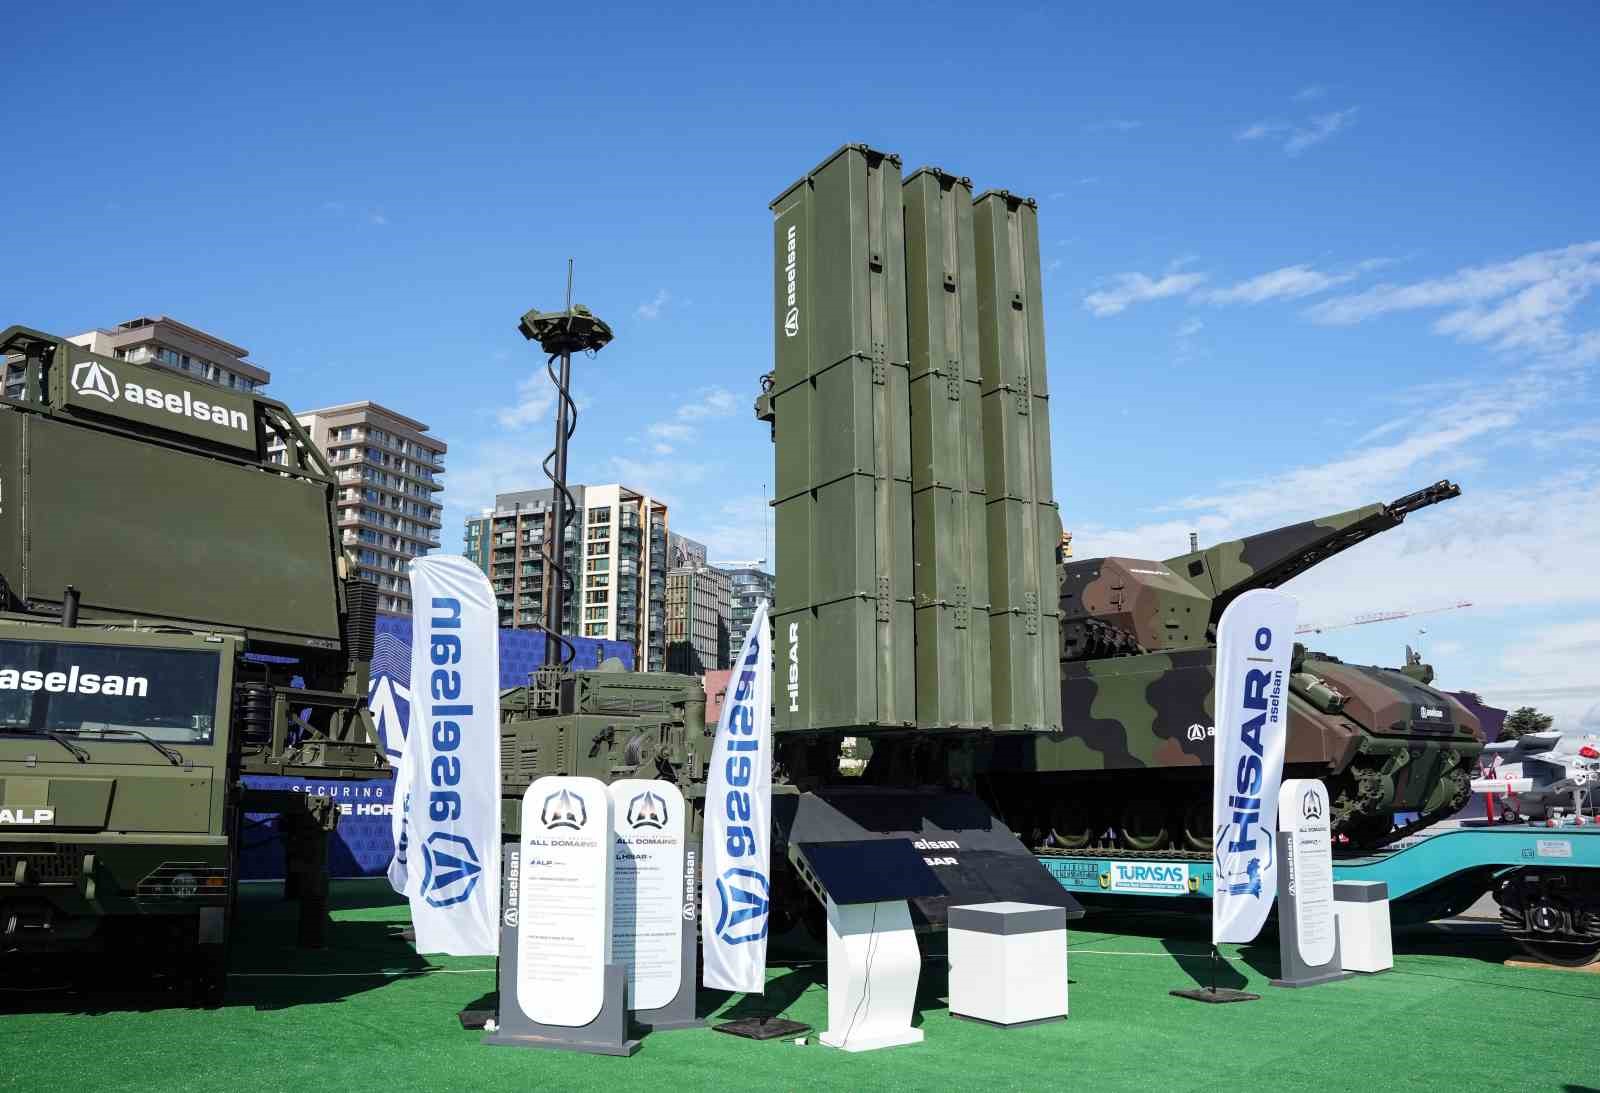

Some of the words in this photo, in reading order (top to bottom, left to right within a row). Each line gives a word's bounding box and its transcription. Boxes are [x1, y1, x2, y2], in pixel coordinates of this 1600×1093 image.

[784, 225, 797, 307] aselsan
[124, 382, 248, 431] aselsan
[0, 665, 148, 697] aselsan
[1269, 669, 1283, 723] aselsan
[912, 838, 960, 850] elsan
[507, 851, 519, 907] aselsan
[684, 851, 695, 902] aselsan
